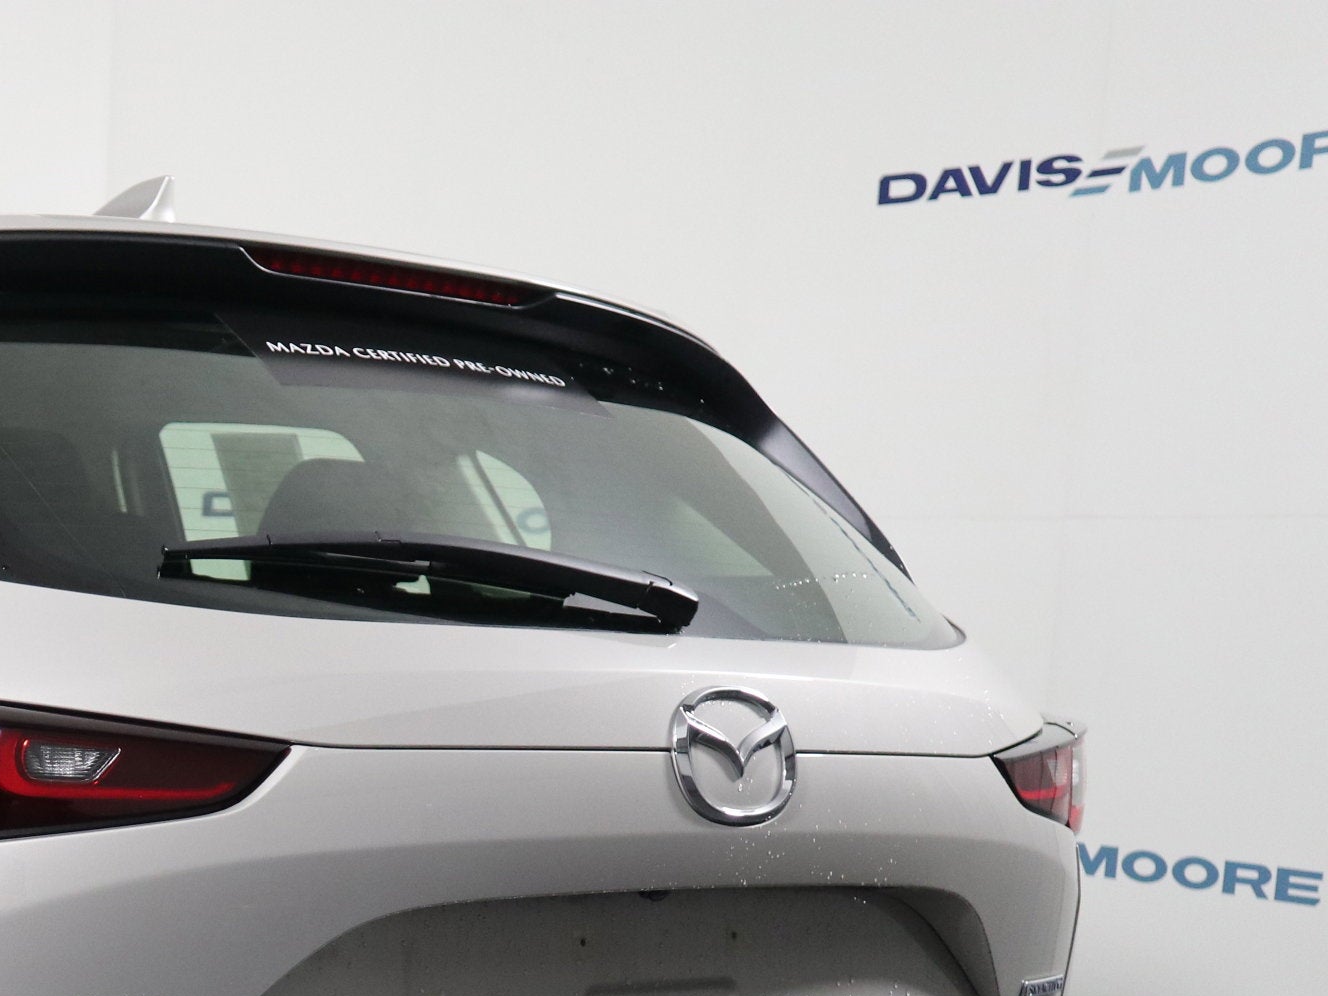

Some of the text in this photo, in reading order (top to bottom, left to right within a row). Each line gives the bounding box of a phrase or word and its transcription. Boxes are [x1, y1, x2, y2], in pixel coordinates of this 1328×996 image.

[877, 154, 1083, 206] DAVIS
[265, 340, 566, 387] MAZDA CERTIFIED PRE-OWNED
[1076, 841, 1324, 907] MOORE
